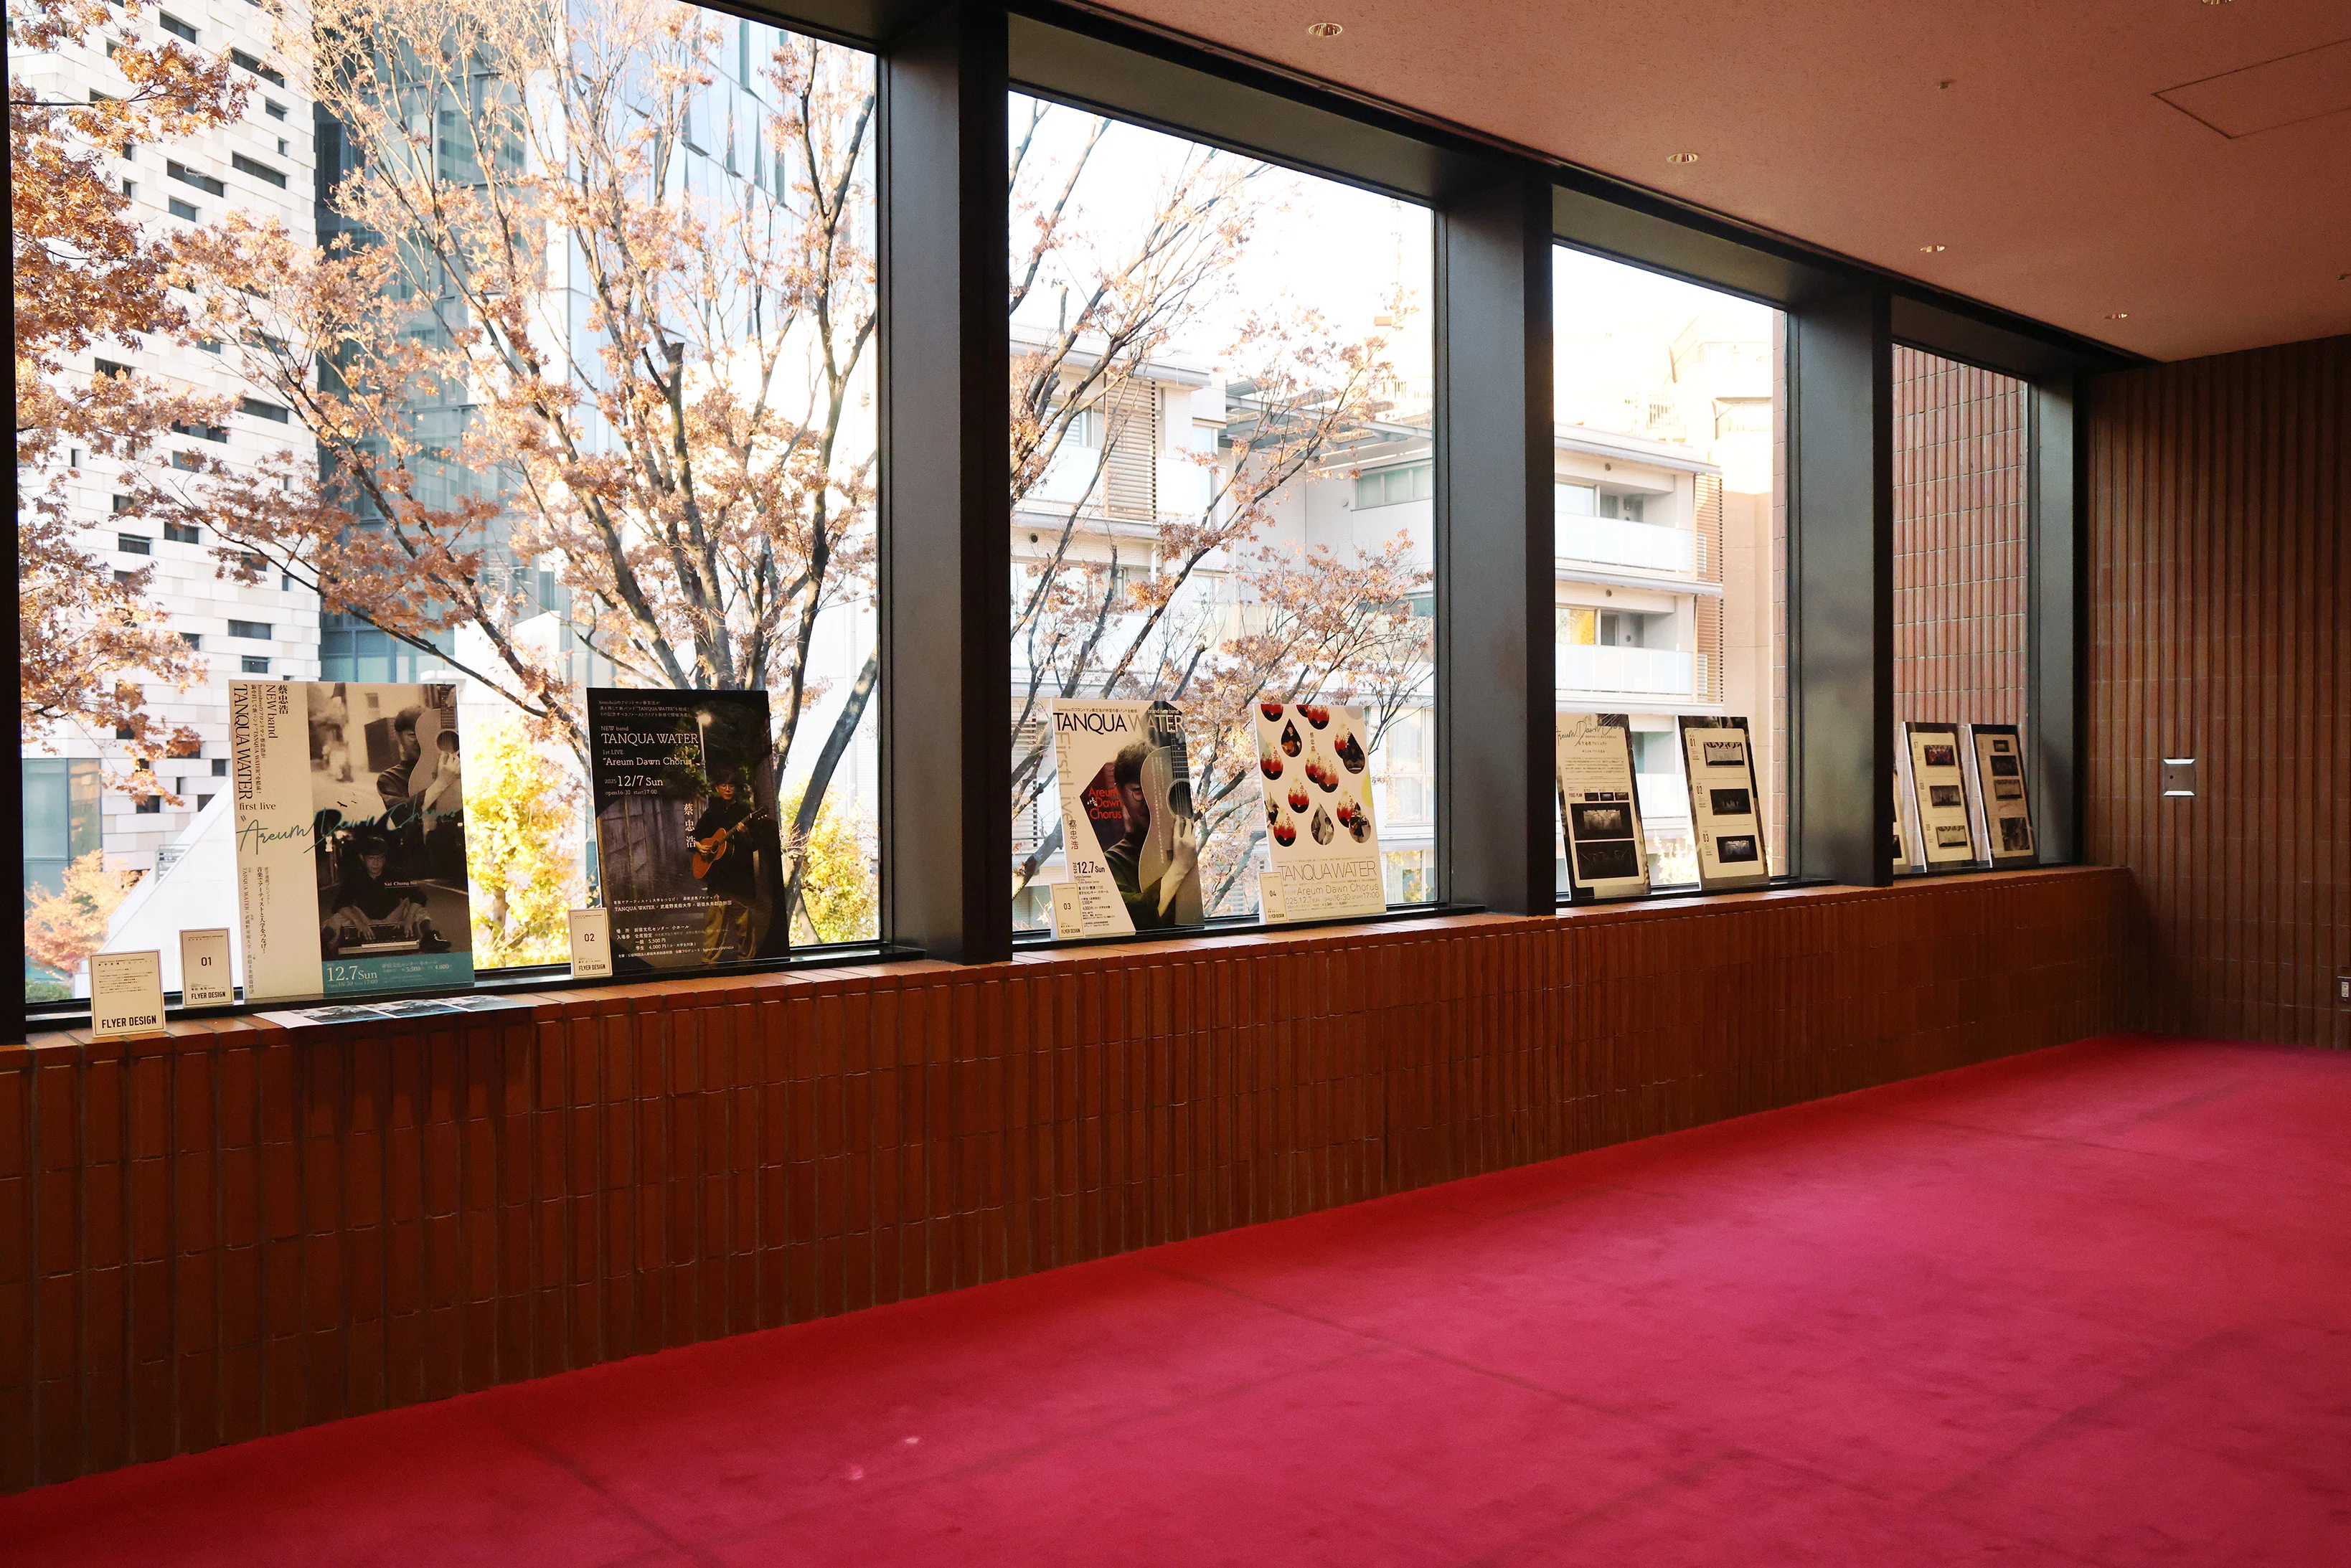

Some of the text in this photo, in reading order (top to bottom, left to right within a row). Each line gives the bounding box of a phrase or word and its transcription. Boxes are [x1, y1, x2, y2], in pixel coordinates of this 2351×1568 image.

[278, 684, 288, 714] 蔡忠浩
[266, 684, 278, 739] NEW band
[1052, 712, 1185, 735] TANQUA WATER
[233, 684, 253, 800] TANQUA WATER
[600, 733, 699, 747] TANQUA WATER
[1055, 732, 1072, 778] First
[618, 775, 644, 788] 12/7
[646, 777, 664, 787] Sun
[1088, 787, 1119, 797] Areum
[1697, 785, 1702, 794] 02
[239, 802, 276, 811] first live
[1096, 798, 1123, 808] Dawn
[1090, 808, 1123, 819] Chorus
[683, 803, 696, 848] 蔡忠浩
[1068, 820, 1079, 850] 蔡忠浩
[1703, 833, 1710, 842] 03
[1077, 861, 1095, 874] 12.7
[1277, 861, 1377, 881] TANQUA WATER
[1296, 887, 1324, 896] Areum
[1326, 884, 1348, 894] Dawn
[1349, 883, 1379, 892] Chorus
[584, 933, 595, 942] 02
[201, 956, 212, 966] 01
[326, 965, 358, 982] 12.7
[358, 970, 377, 980] Sun
[102, 1015, 156, 1029] FLYER DESIGN
